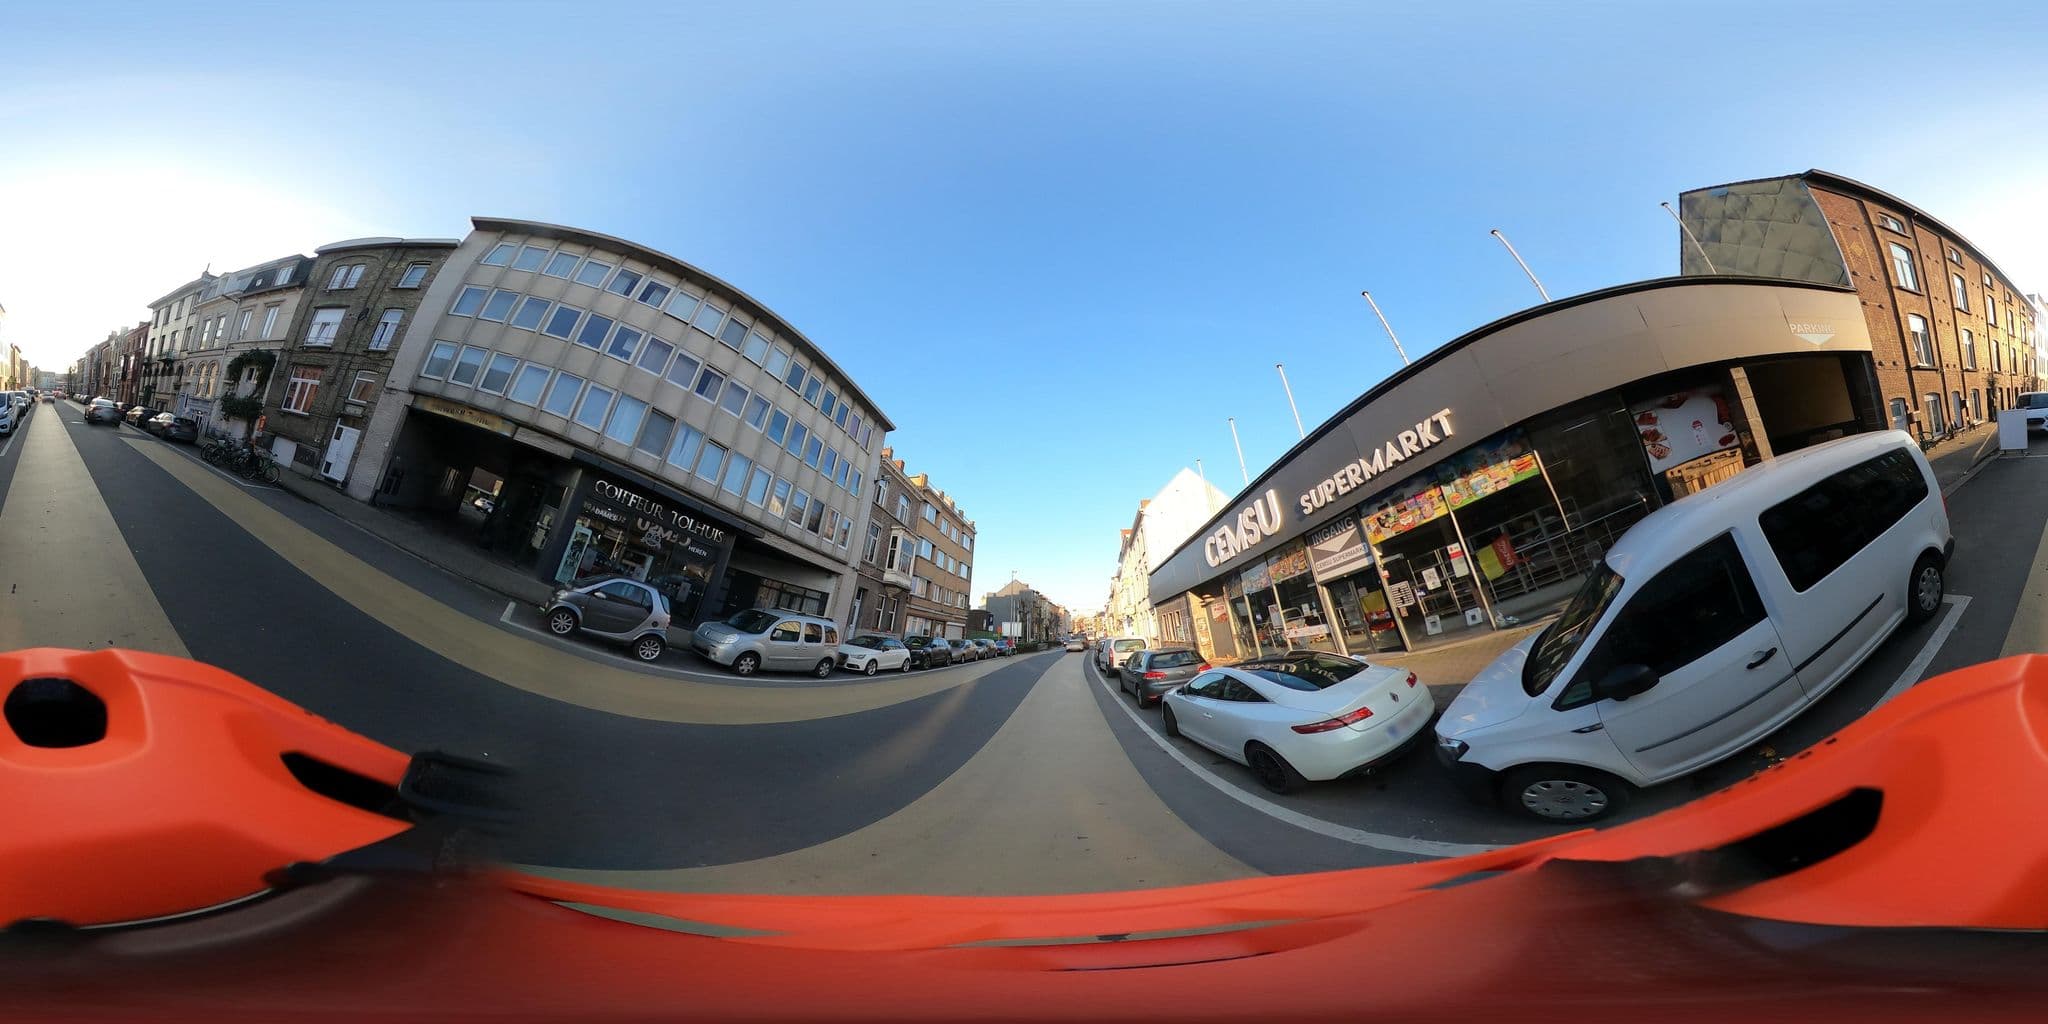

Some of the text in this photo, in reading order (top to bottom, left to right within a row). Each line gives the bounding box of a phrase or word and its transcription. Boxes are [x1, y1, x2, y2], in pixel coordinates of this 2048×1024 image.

[1203, 408, 1455, 568] CEMSU SUPERMARKT
[595, 480, 664, 520] COIFFEUR
[671, 510, 725, 543] TOLHUIS
[1311, 517, 1354, 546] INGANG
[687, 546, 707, 557] HEREN
[1332, 544, 1368, 562] SUPERMARKT
